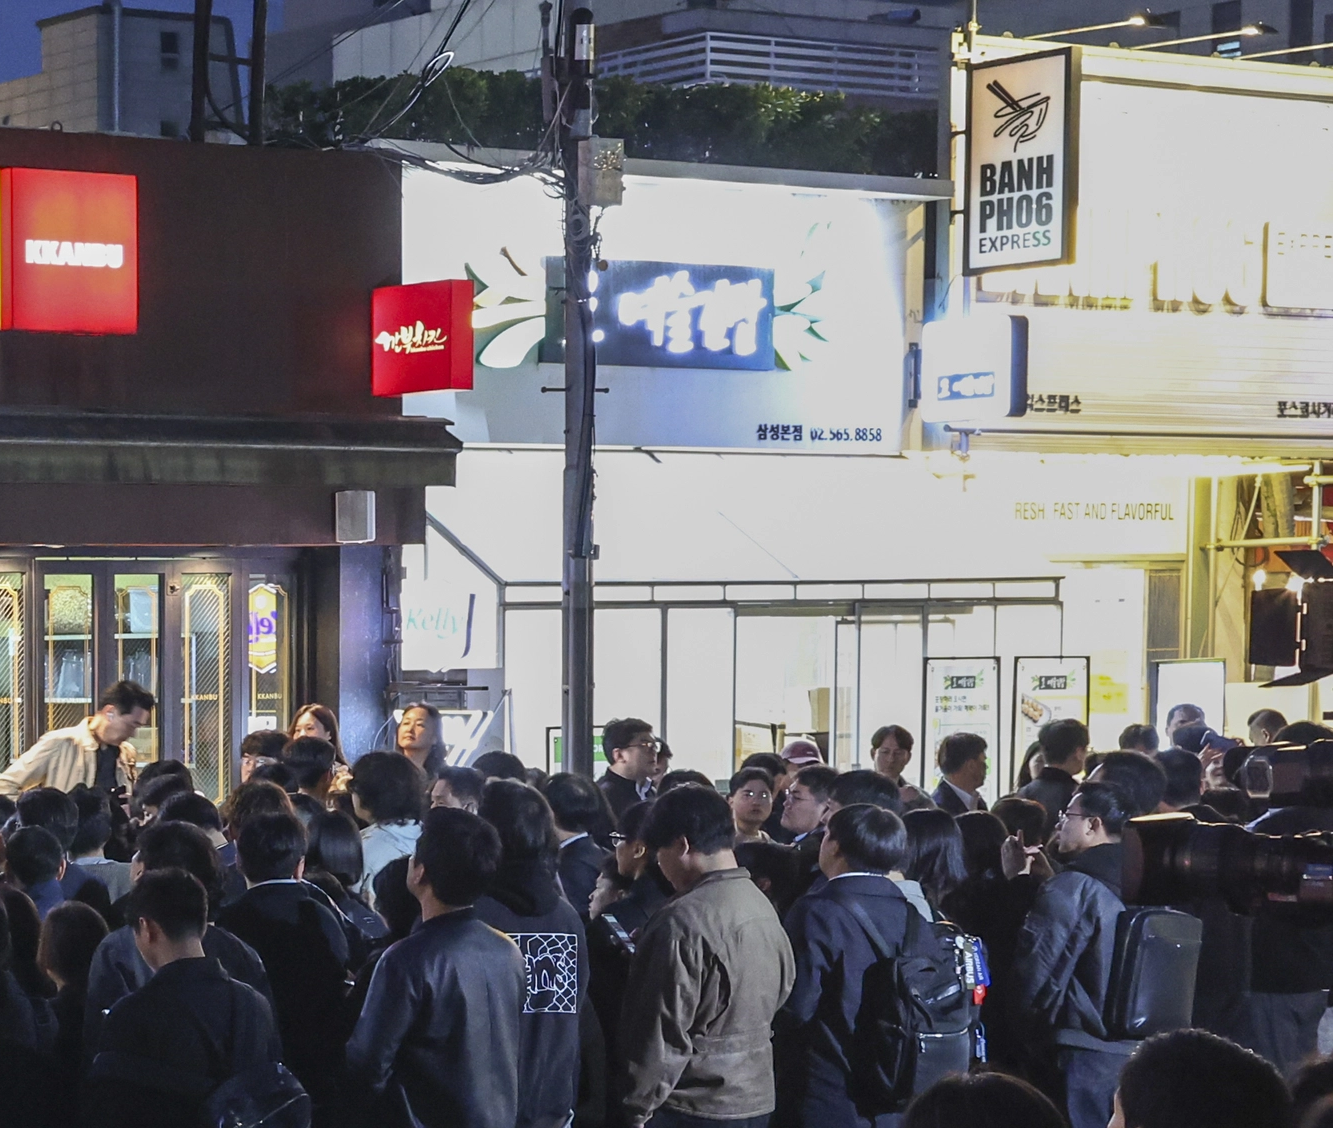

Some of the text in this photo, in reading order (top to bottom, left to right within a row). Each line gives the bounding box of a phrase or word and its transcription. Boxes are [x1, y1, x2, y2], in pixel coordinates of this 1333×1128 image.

[980, 154, 1054, 197] BANH
[25, 239, 123, 268] KKANBU
[979, 229, 1051, 254] EXPRESS
[757, 423, 882, 442] 삼성본점 02.565.8858
[1053, 502, 1080, 520] FAST
[1084, 502, 1107, 520] AND
[1111, 502, 1174, 521] FLAVORFUL
[964, 951, 975, 984] AIRBUS
